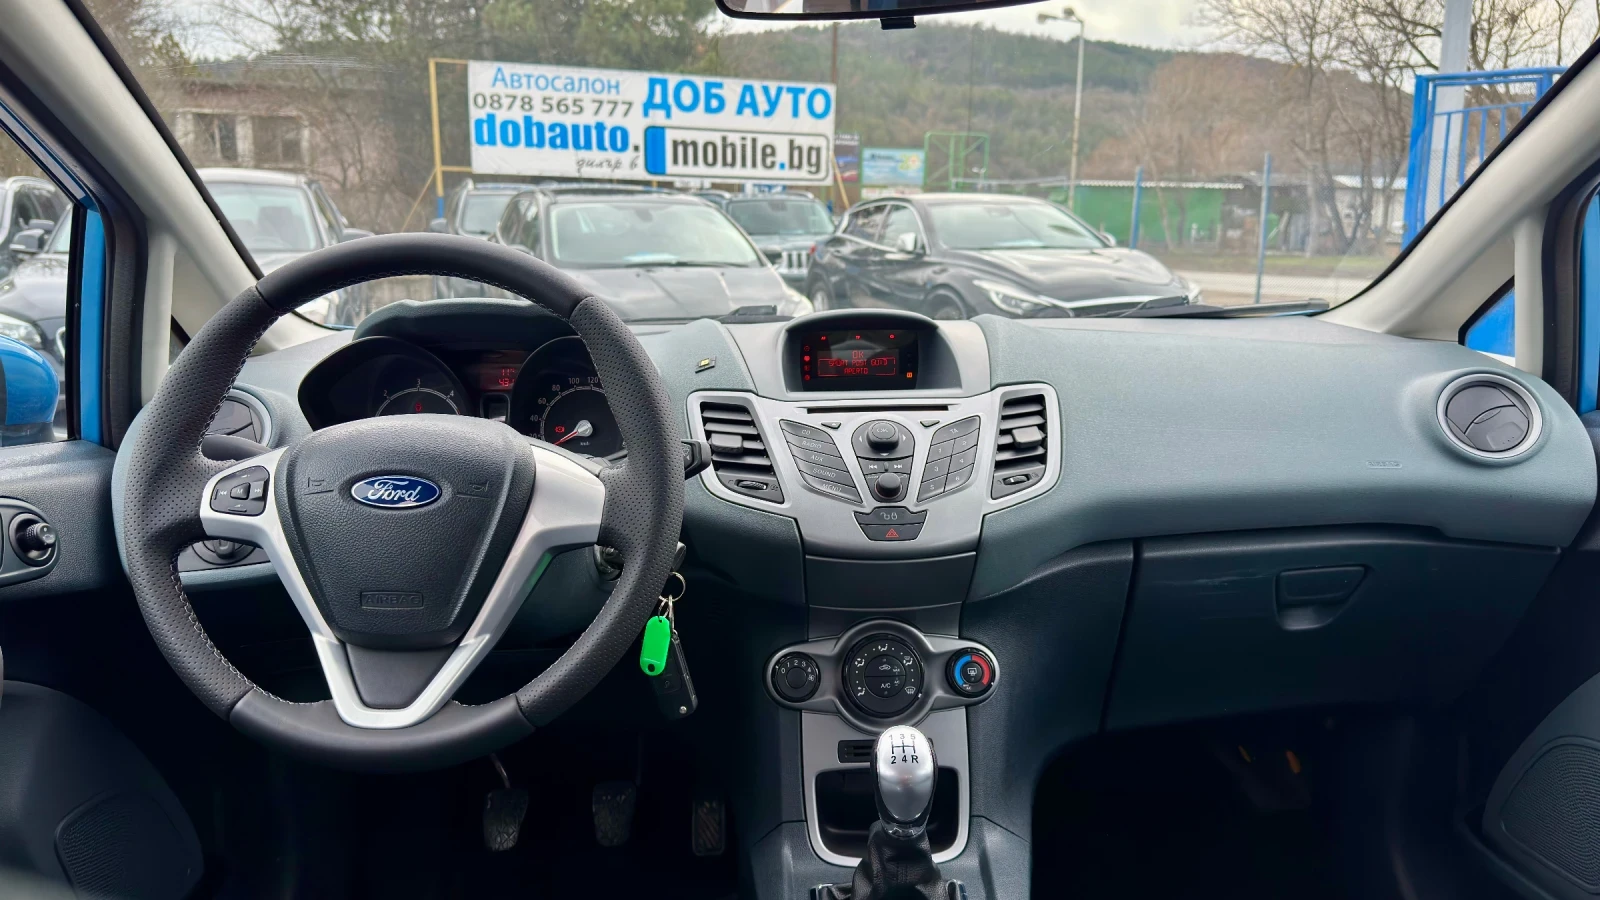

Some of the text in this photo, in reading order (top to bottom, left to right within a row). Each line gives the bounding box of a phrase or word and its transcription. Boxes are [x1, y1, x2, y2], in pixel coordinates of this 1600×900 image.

[491, 66, 620, 95] Автосалон
[643, 77, 832, 119] ДОБ АУТО
[473, 93, 634, 118] 0878 565 777
[672, 136, 822, 174] mobile.bg
[852, 350, 864, 359] OK
[844, 367, 869, 375] APERTO
[568, 377, 580, 385] 100
[587, 376, 599, 384] 120
[551, 384, 561, 392] 80
[383, 389, 388, 397] 2
[537, 397, 547, 405] 60
[801, 440, 822, 450] RADIO
[810, 454, 824, 463] AUX
[812, 467, 836, 479] SOUND
[367, 479, 422, 501] Ford
[364, 594, 421, 604] AIRBAG
[801, 660, 806, 668] 3
[891, 754, 919, 764] 2 4 R
